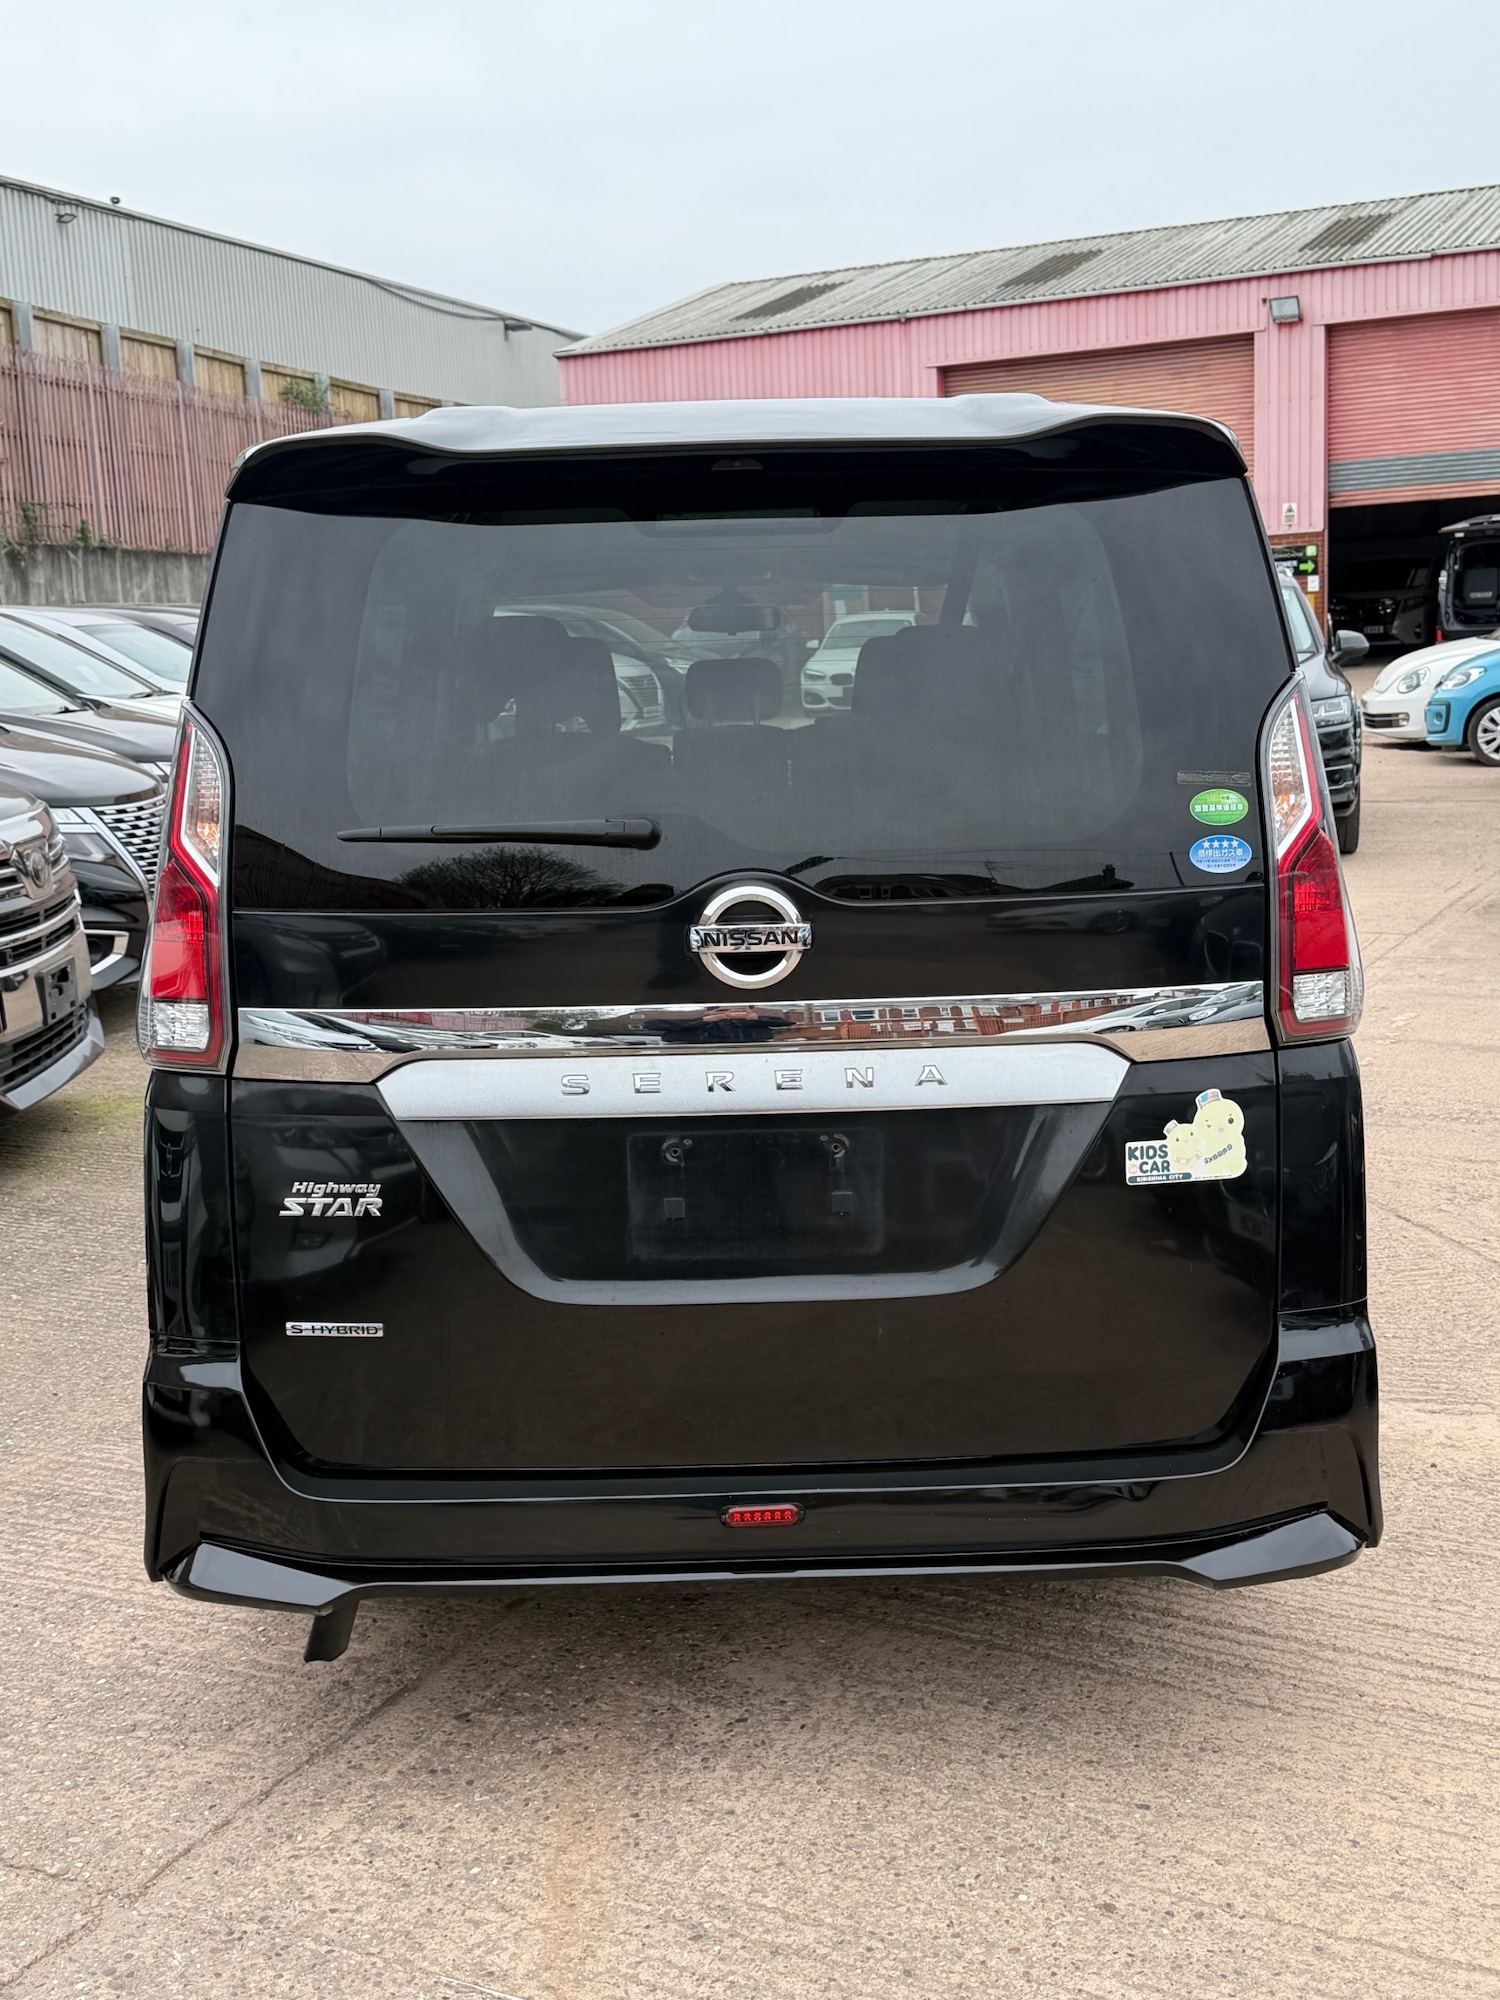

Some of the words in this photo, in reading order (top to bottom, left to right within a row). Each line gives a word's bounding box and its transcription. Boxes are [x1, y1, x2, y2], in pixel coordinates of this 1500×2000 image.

[703, 930, 798, 947] NISSAN
[560, 1064, 949, 1096] SERENA
[1127, 1144, 1169, 1162] KIDS
[1138, 1160, 1171, 1174] CAR
[291, 1181, 382, 1198] Highway
[278, 1197, 383, 1217] STAR
